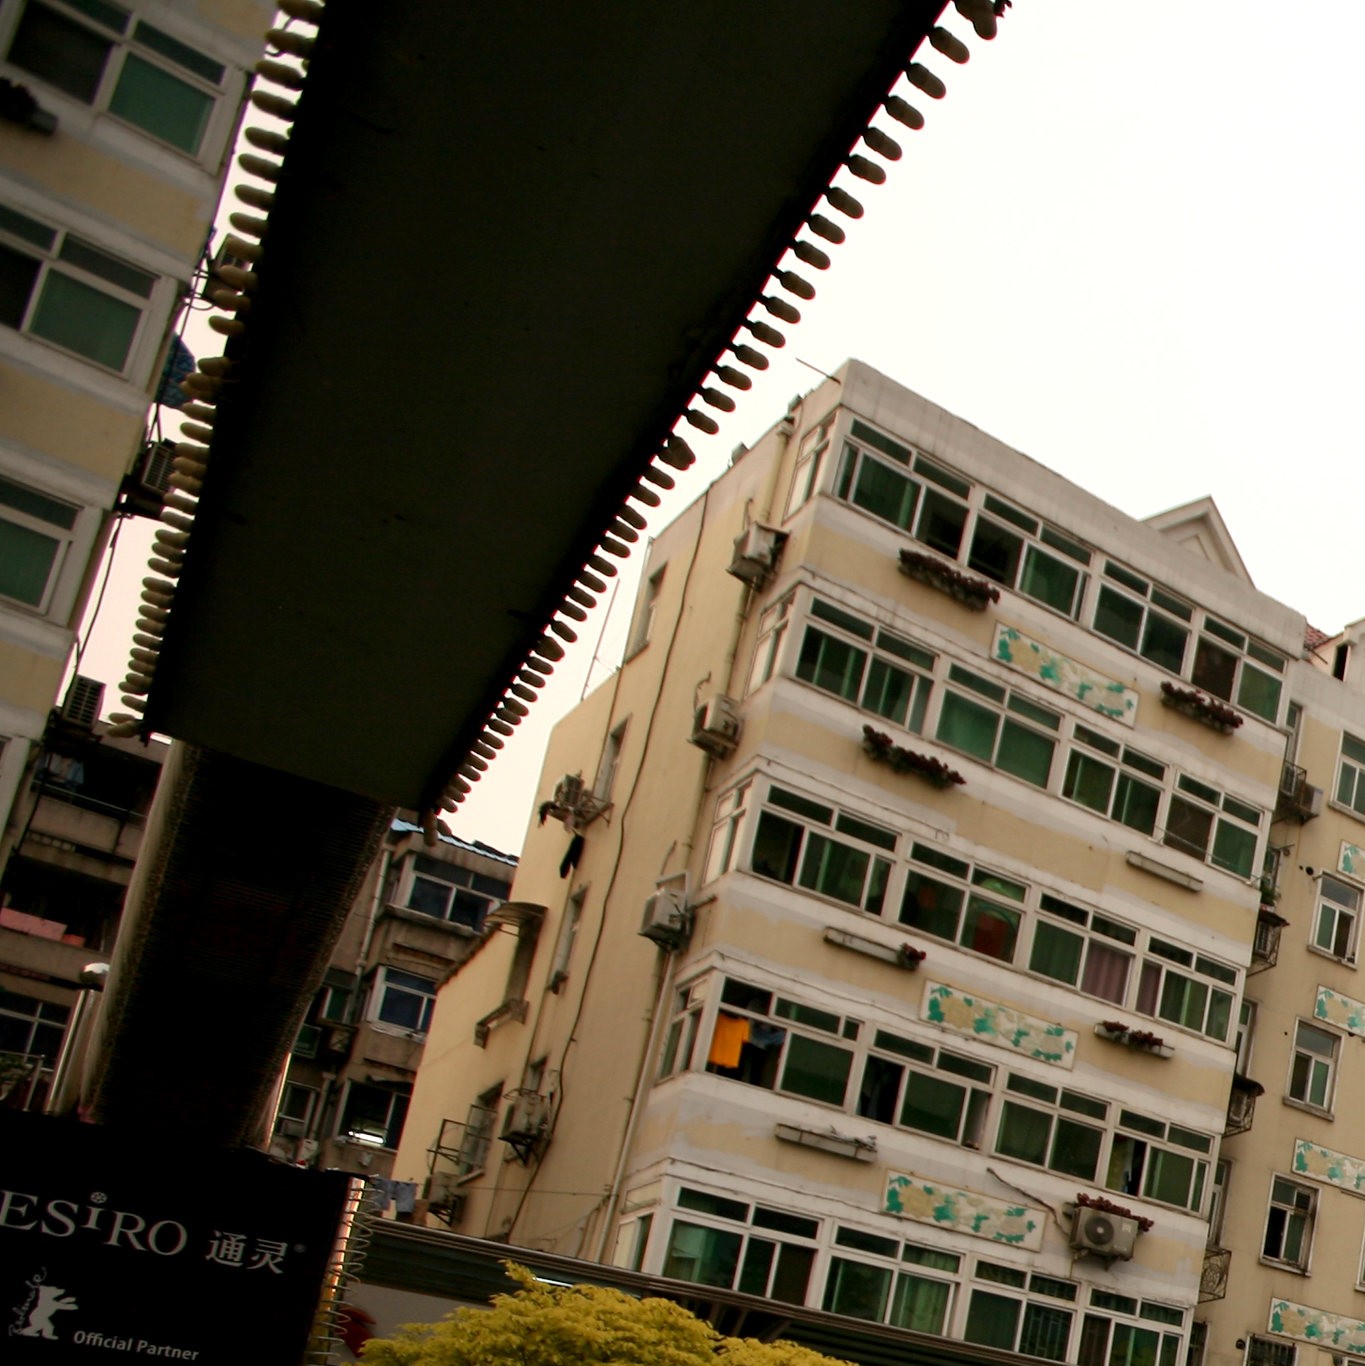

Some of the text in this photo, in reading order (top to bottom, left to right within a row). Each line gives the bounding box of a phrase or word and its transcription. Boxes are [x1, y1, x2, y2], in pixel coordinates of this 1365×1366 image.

[205, 1230, 290, 1274] 通灵
[73, 1329, 200, 1361] Official Partner
